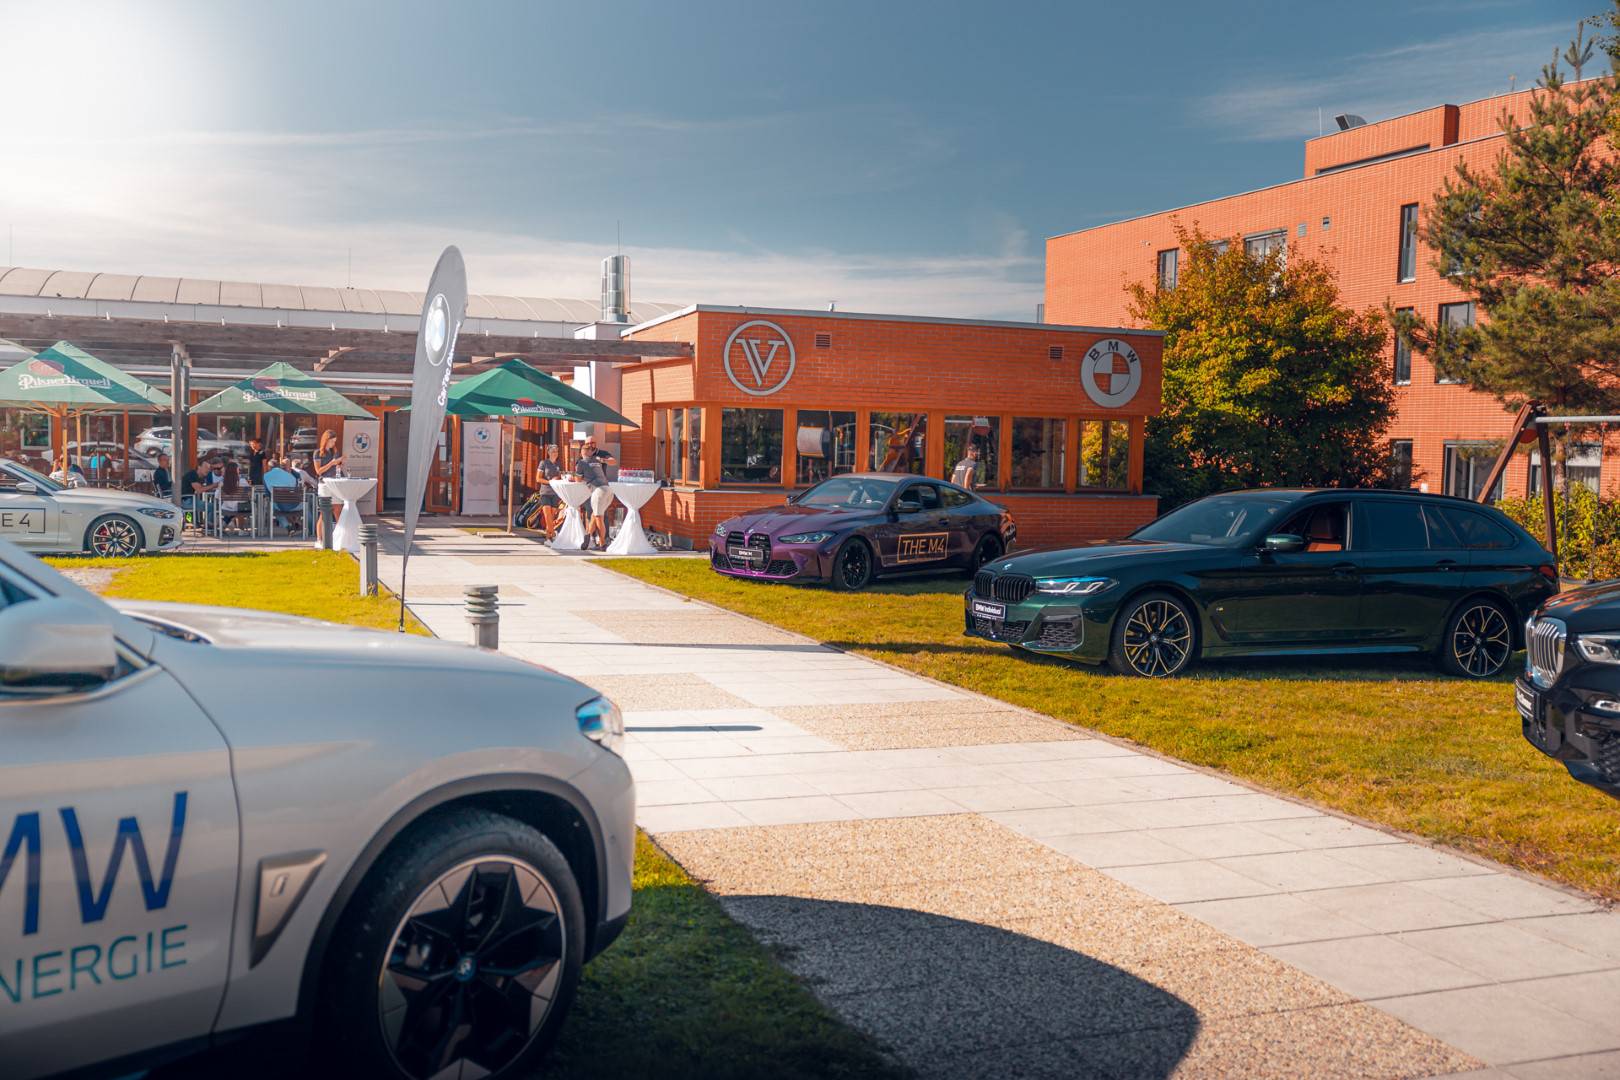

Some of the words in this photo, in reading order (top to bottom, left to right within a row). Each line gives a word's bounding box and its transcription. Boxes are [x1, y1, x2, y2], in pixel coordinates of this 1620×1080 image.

[1088, 340, 1138, 364] BMW
[18, 374, 66, 390] Pilsner
[63, 374, 111, 389] Urquell
[279, 388, 317, 400] Urquell
[19, 512, 30, 528] 4
[902, 539, 927, 556] THE
[927, 538, 945, 554] M4
